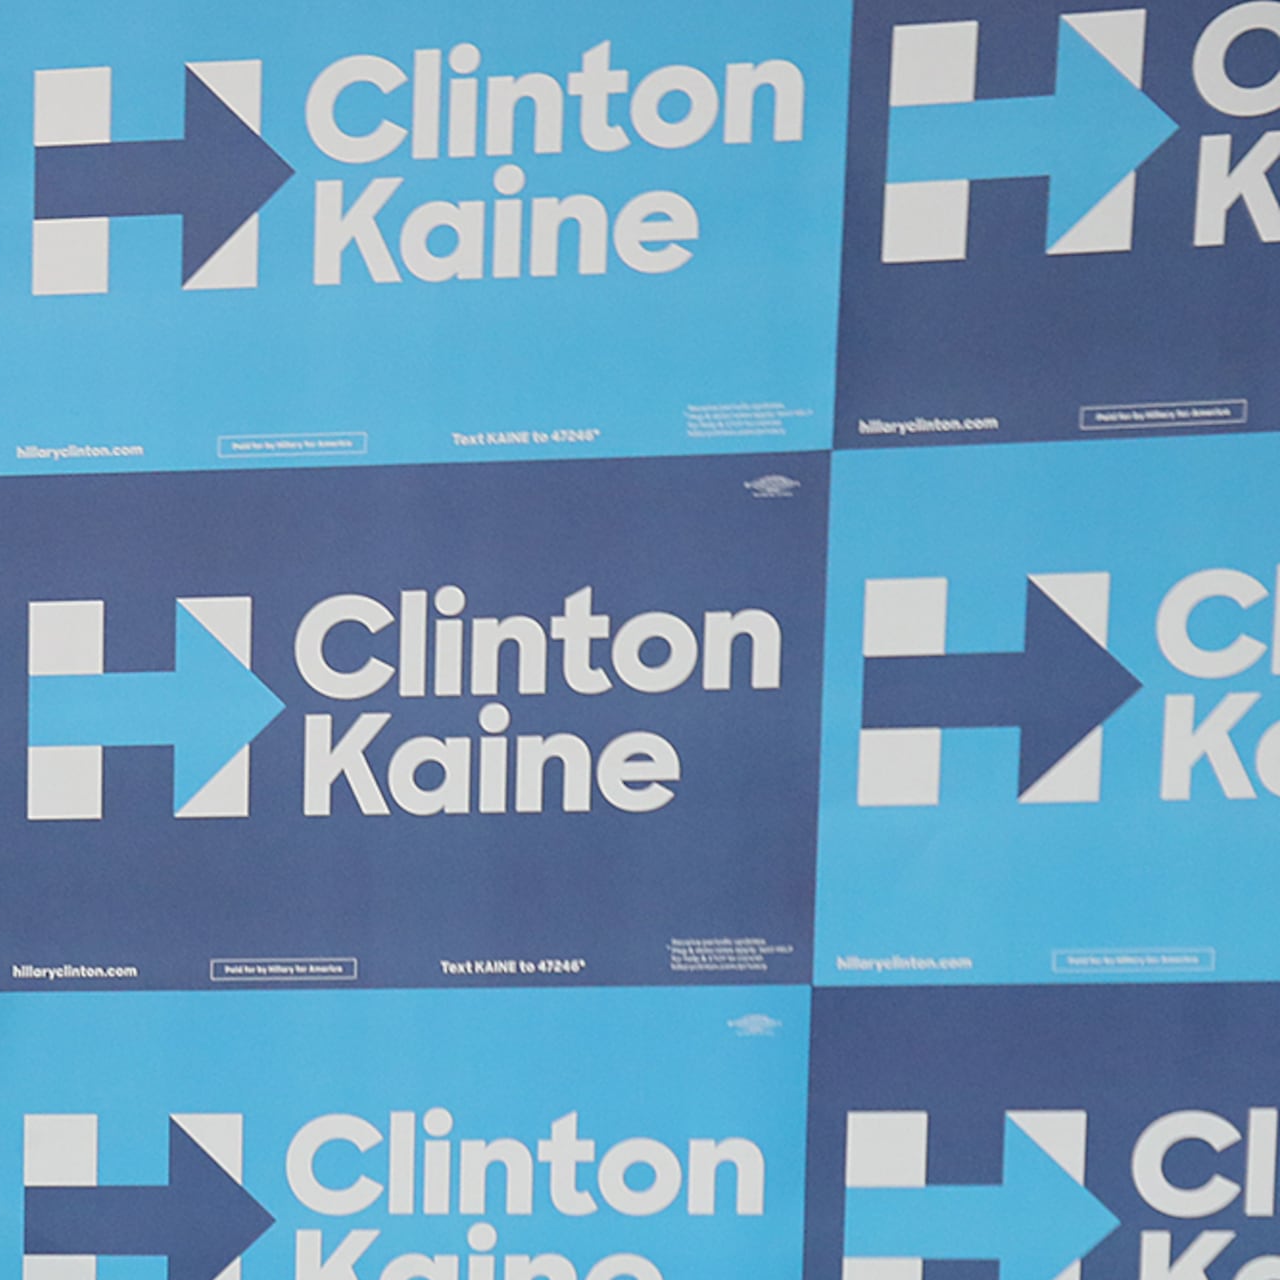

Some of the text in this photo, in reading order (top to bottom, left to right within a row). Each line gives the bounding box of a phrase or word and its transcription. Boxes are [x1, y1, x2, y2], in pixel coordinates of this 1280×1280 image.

[306, 41, 804, 163] Clinton
[313, 164, 698, 285] Kaine
[16, 442, 143, 462] hillaryclinton.com
[450, 431, 485, 445] Text
[486, 429, 530, 444] KAINE
[531, 429, 549, 443] to
[295, 586, 780, 699] Clinton
[304, 703, 679, 815] Kaine
[12, 963, 137, 980] hillaryclinton.com
[439, 960, 473, 973] Text
[474, 959, 517, 973] KAINE
[518, 959, 536, 972] to
[286, 1107, 764, 1216] Clinton
